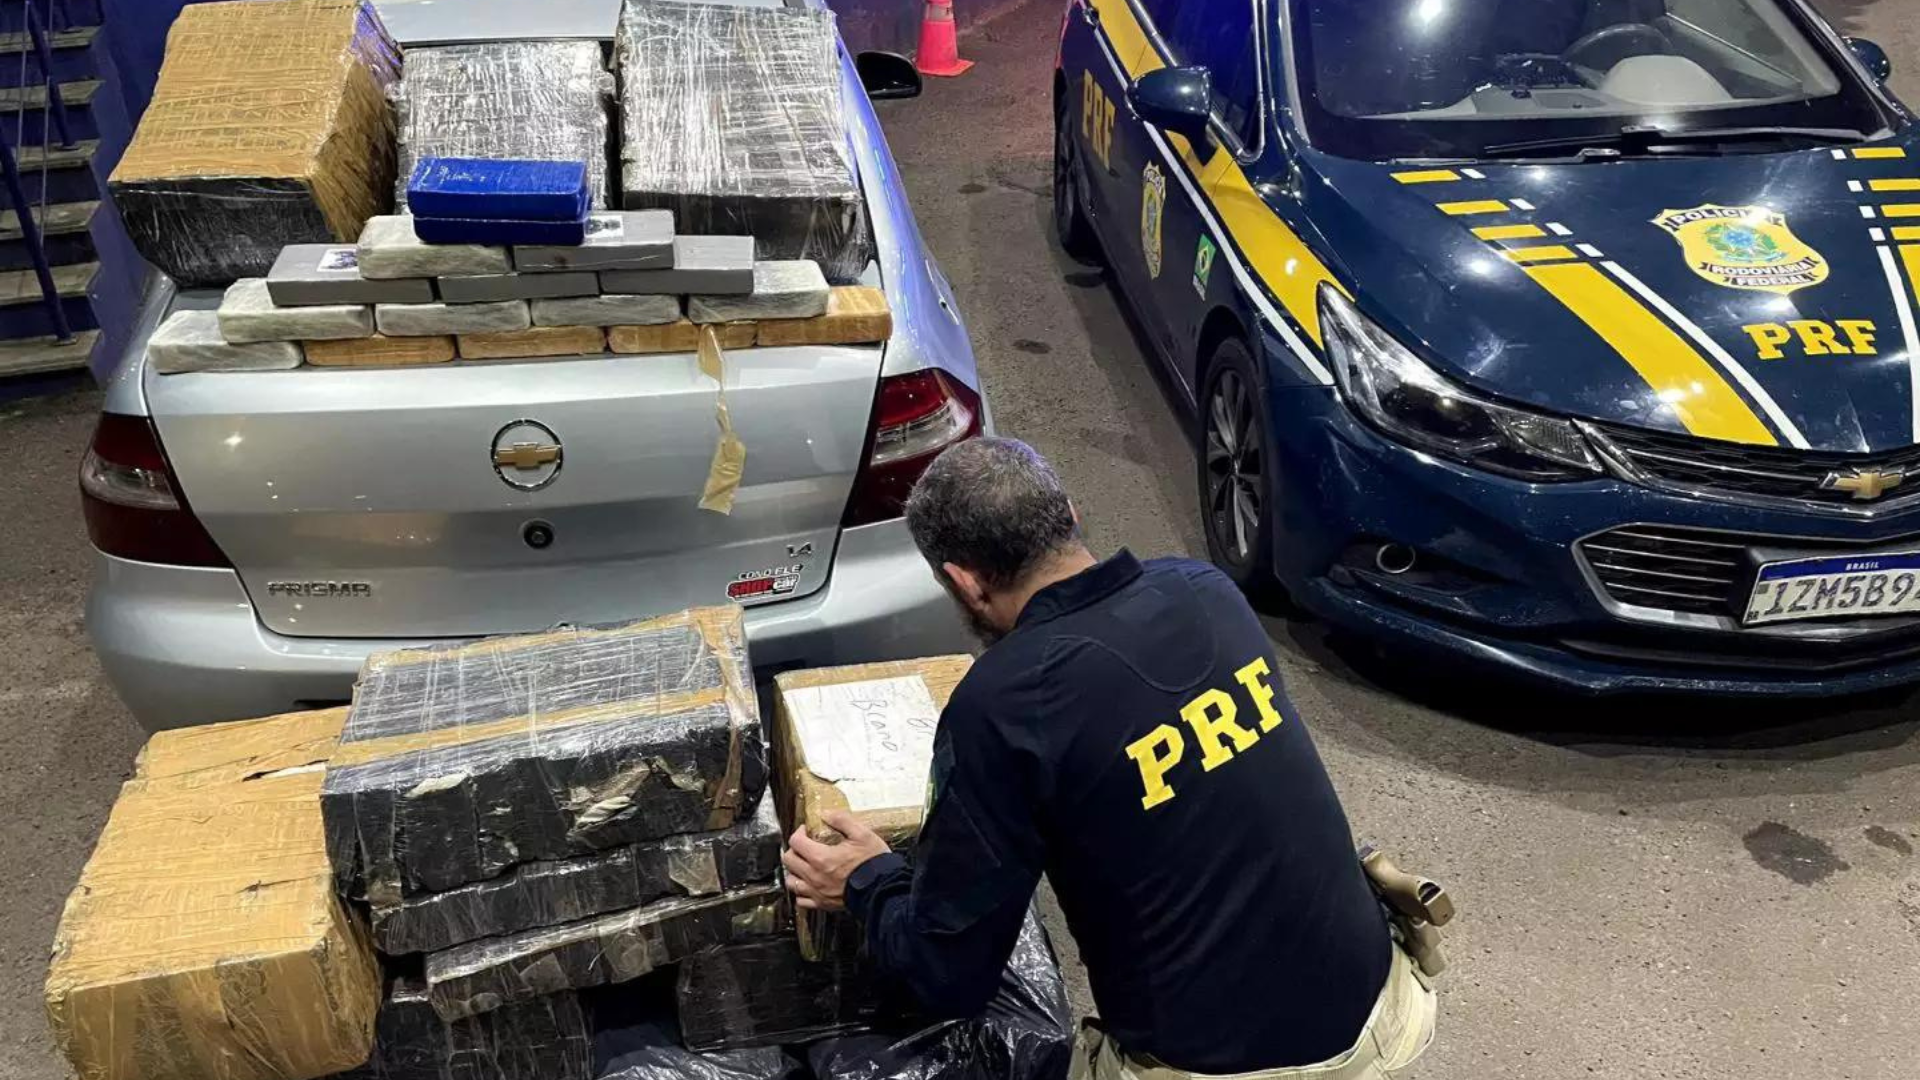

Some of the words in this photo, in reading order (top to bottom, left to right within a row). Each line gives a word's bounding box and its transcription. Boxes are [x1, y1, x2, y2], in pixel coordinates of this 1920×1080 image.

[1083, 69, 1115, 170] PRF
[1743, 320, 1877, 360] PRF
[1845, 562, 1880, 571] BRASIL
[267, 580, 371, 597] PRISMA
[1125, 656, 1283, 810] PRF
